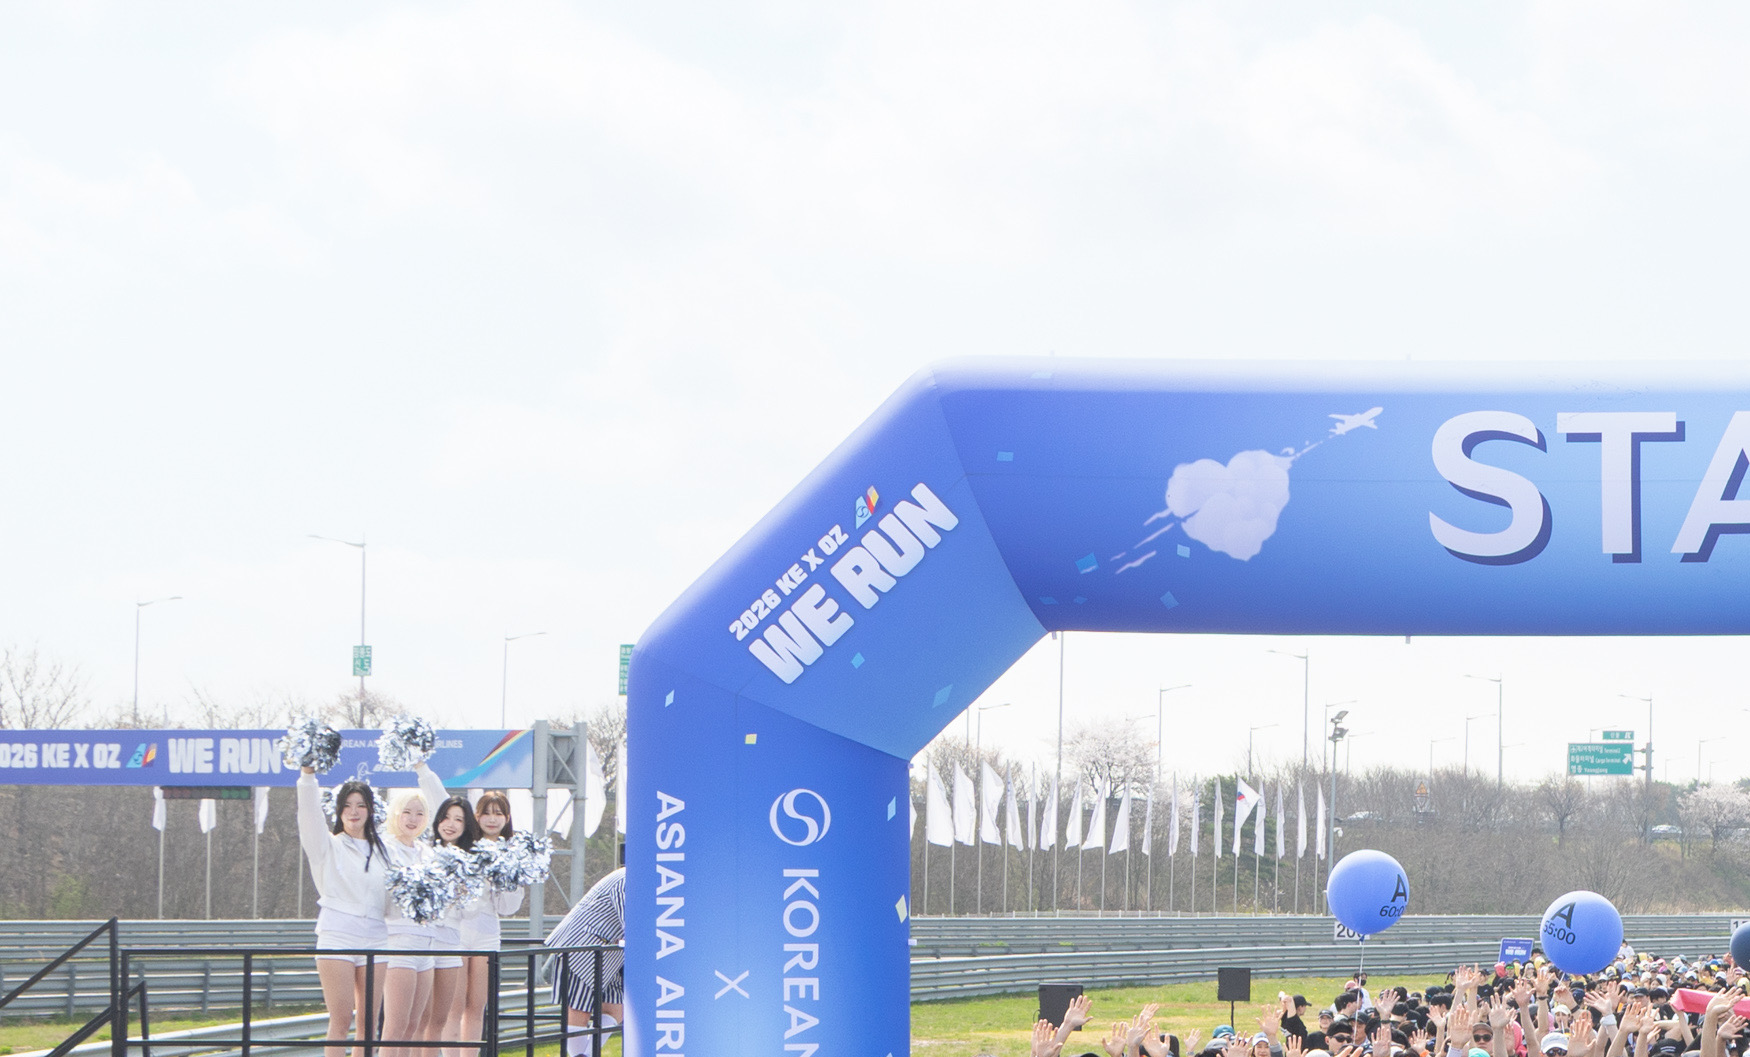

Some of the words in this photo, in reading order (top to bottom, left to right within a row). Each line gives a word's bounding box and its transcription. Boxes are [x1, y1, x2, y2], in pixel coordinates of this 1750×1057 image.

[729, 588, 781, 641] 2026
[775, 563, 808, 596] KE
[801, 548, 824, 572] X
[818, 524, 849, 555] OZ
[748, 583, 854, 684] WE
[830, 482, 959, 609] RUN
[42, 743, 70, 768] KE
[73, 743, 90, 768] X
[93, 743, 121, 768] OZ
[168, 738, 214, 773] WE
[219, 738, 282, 773] RUN
[656, 791, 685, 960] ASIANA
[1391, 874, 1408, 902] A
[1551, 902, 1577, 929] A
[714, 970, 750, 999] X
